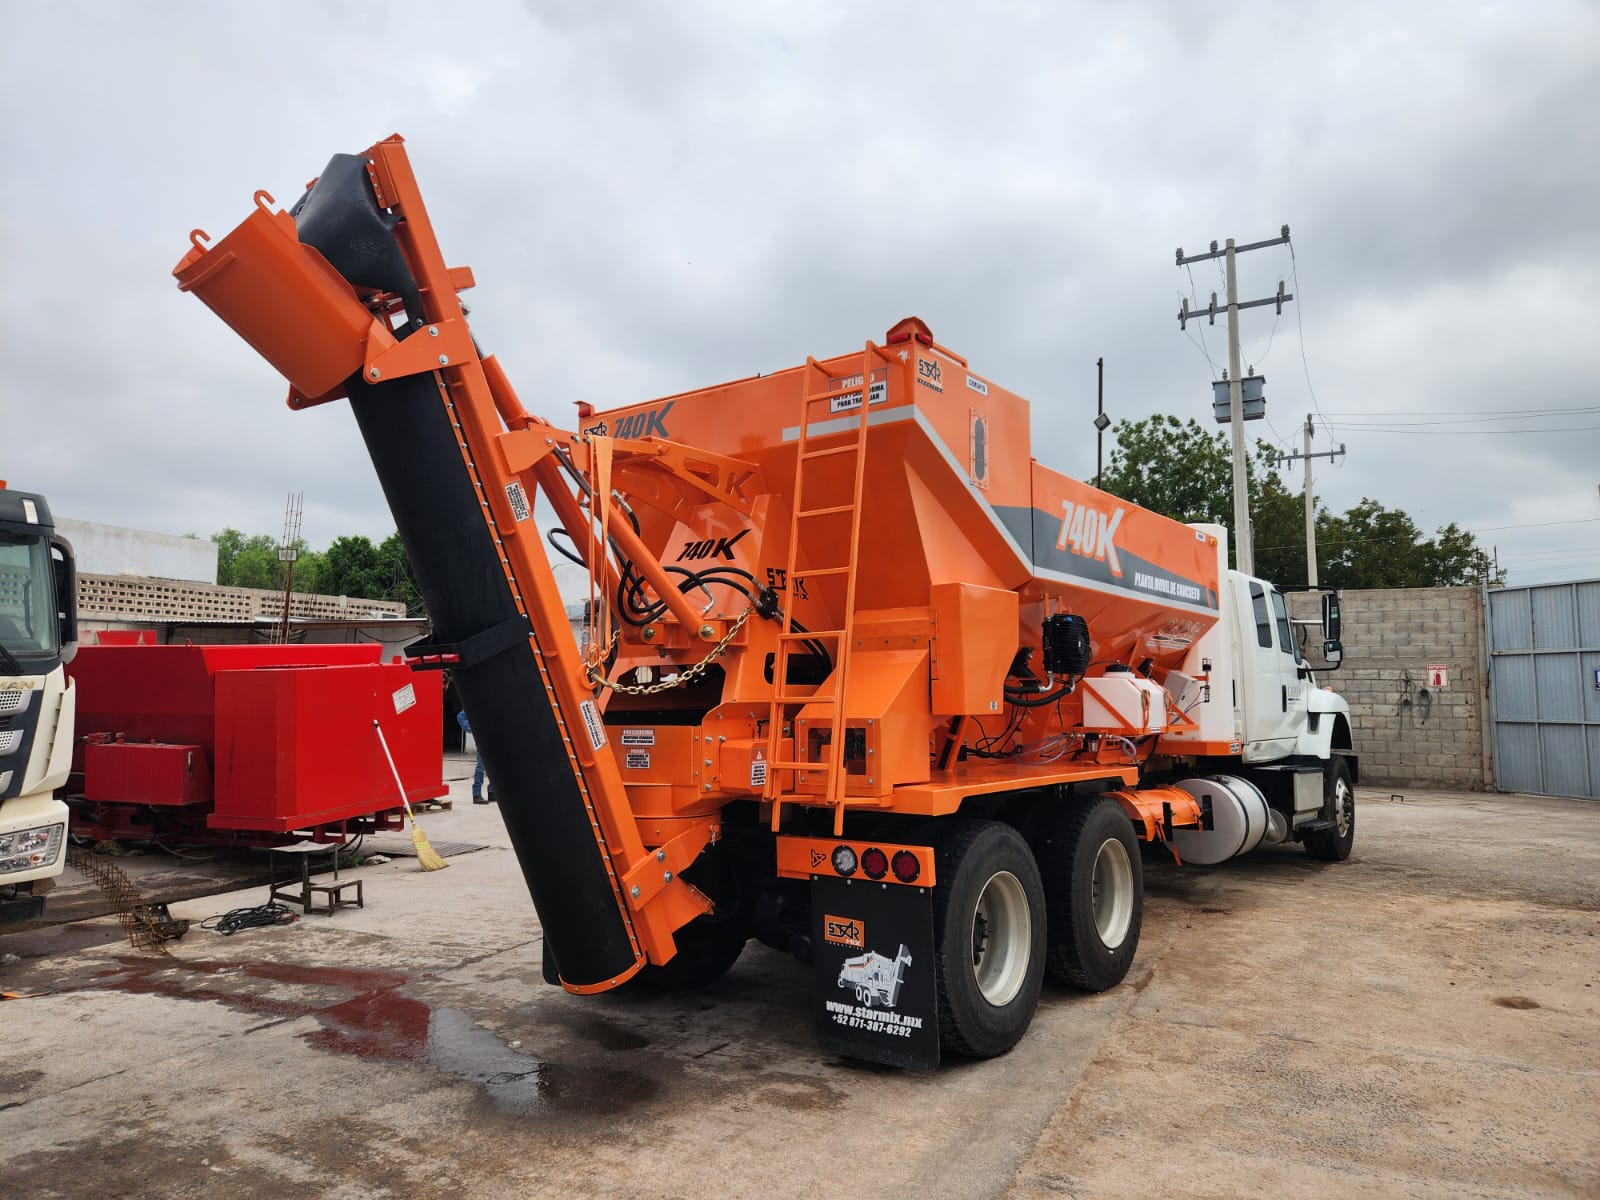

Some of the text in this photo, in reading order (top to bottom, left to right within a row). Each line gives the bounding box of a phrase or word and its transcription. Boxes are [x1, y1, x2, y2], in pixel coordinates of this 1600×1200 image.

[842, 373, 875, 389] PELIGO
[852, 393, 880, 404] TRAJAR
[614, 400, 676, 440] 740K
[676, 528, 752, 561] 740K
[1057, 500, 1124, 577] 740K
[767, 568, 808, 594] STR
[1134, 572, 1153, 590] PLANTA
[1169, 581, 1177, 595] DE
[1176, 583, 1201, 601] CONCRETO
[828, 920, 860, 941] STAR
[825, 1000, 923, 1029] www.starmix.mx
[832, 1013, 849, 1025] +52
